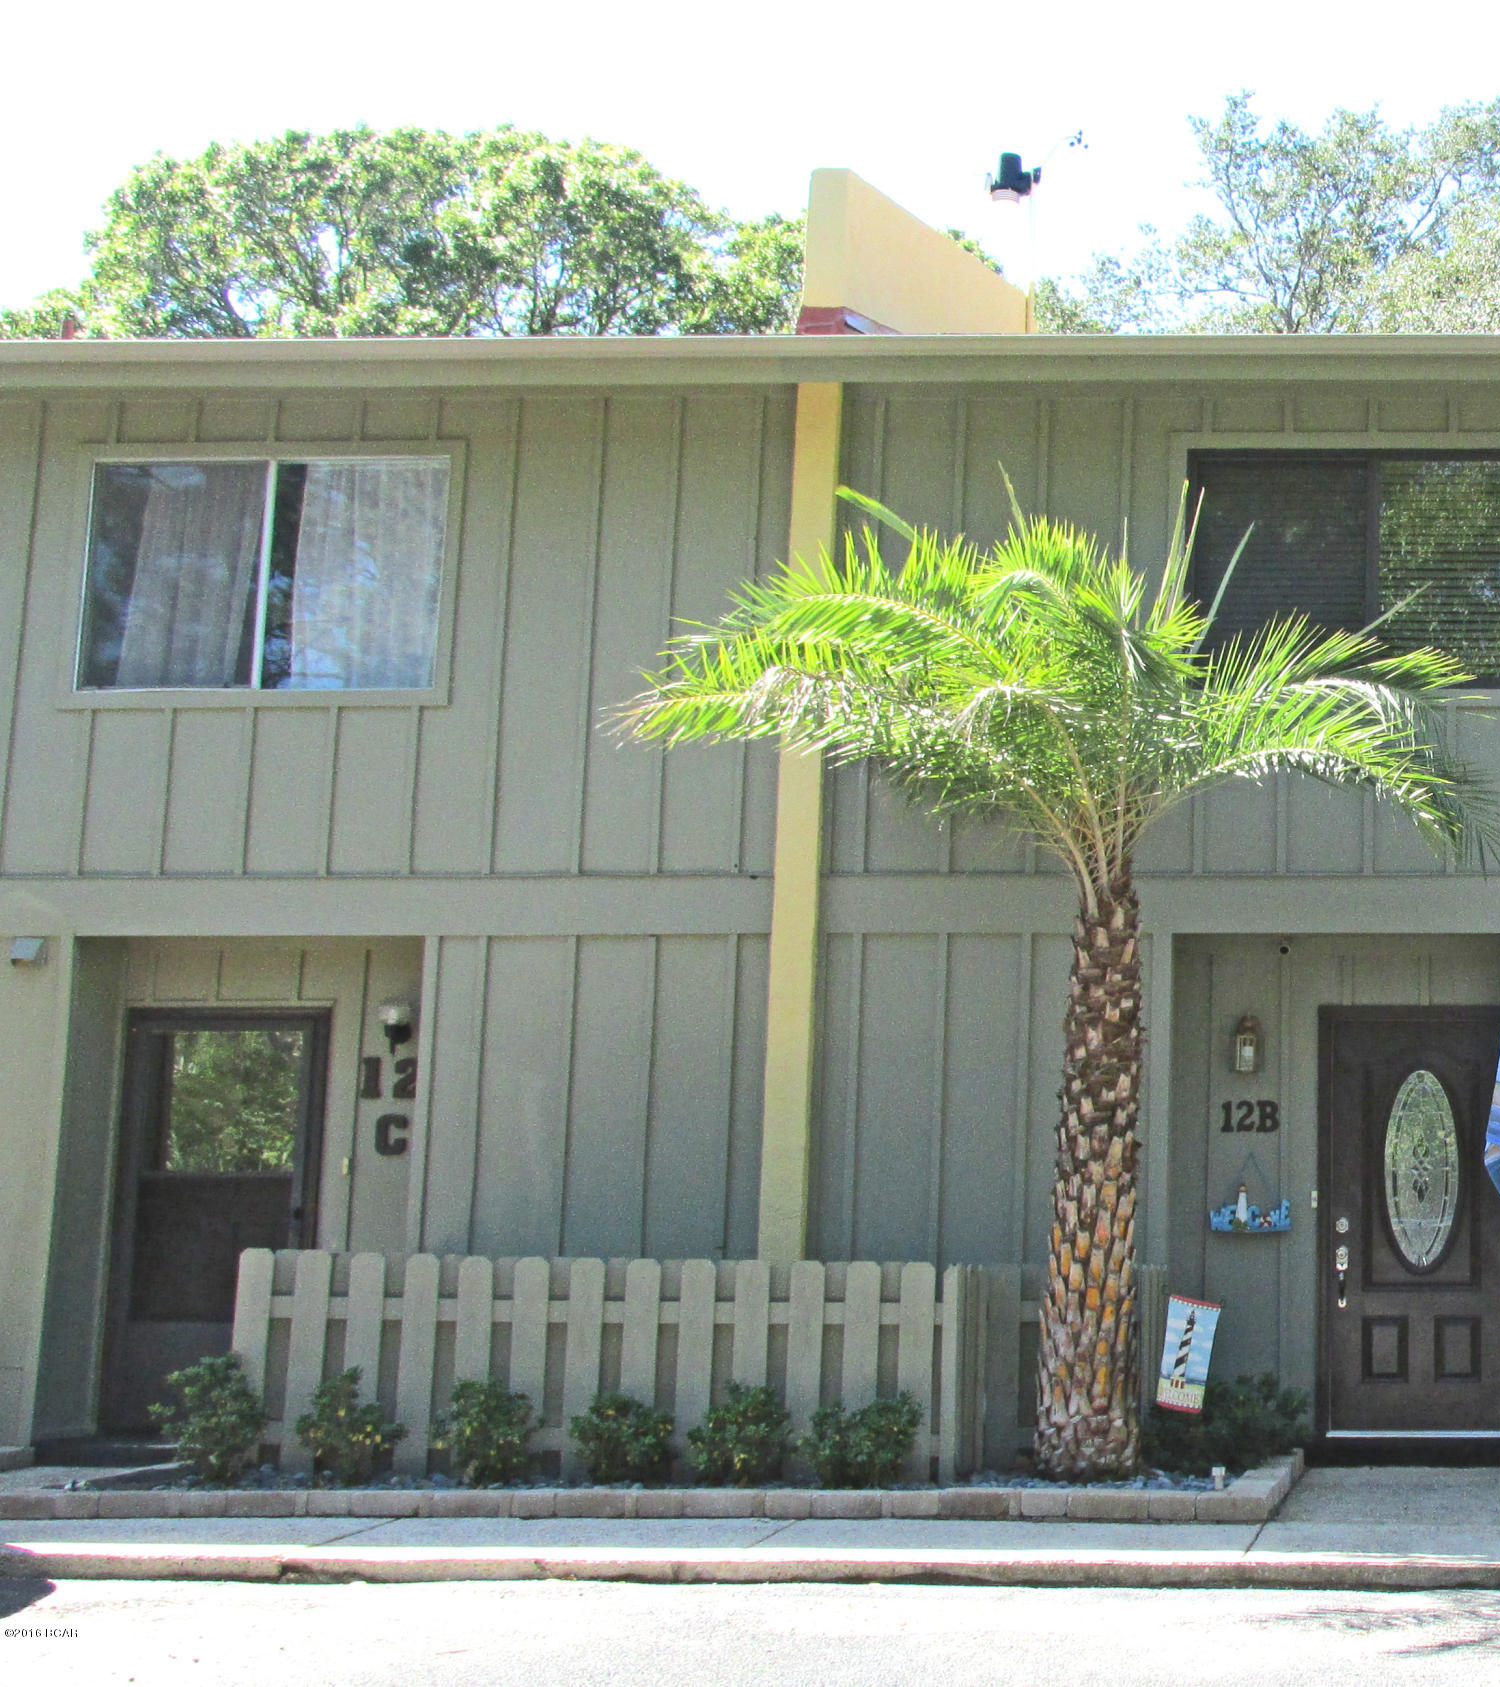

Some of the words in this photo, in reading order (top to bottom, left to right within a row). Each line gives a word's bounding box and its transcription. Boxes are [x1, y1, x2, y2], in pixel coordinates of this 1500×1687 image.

[361, 1056, 419, 1099] 12
[374, 1114, 410, 1156] C
[1221, 1100, 1279, 1133] 12B
